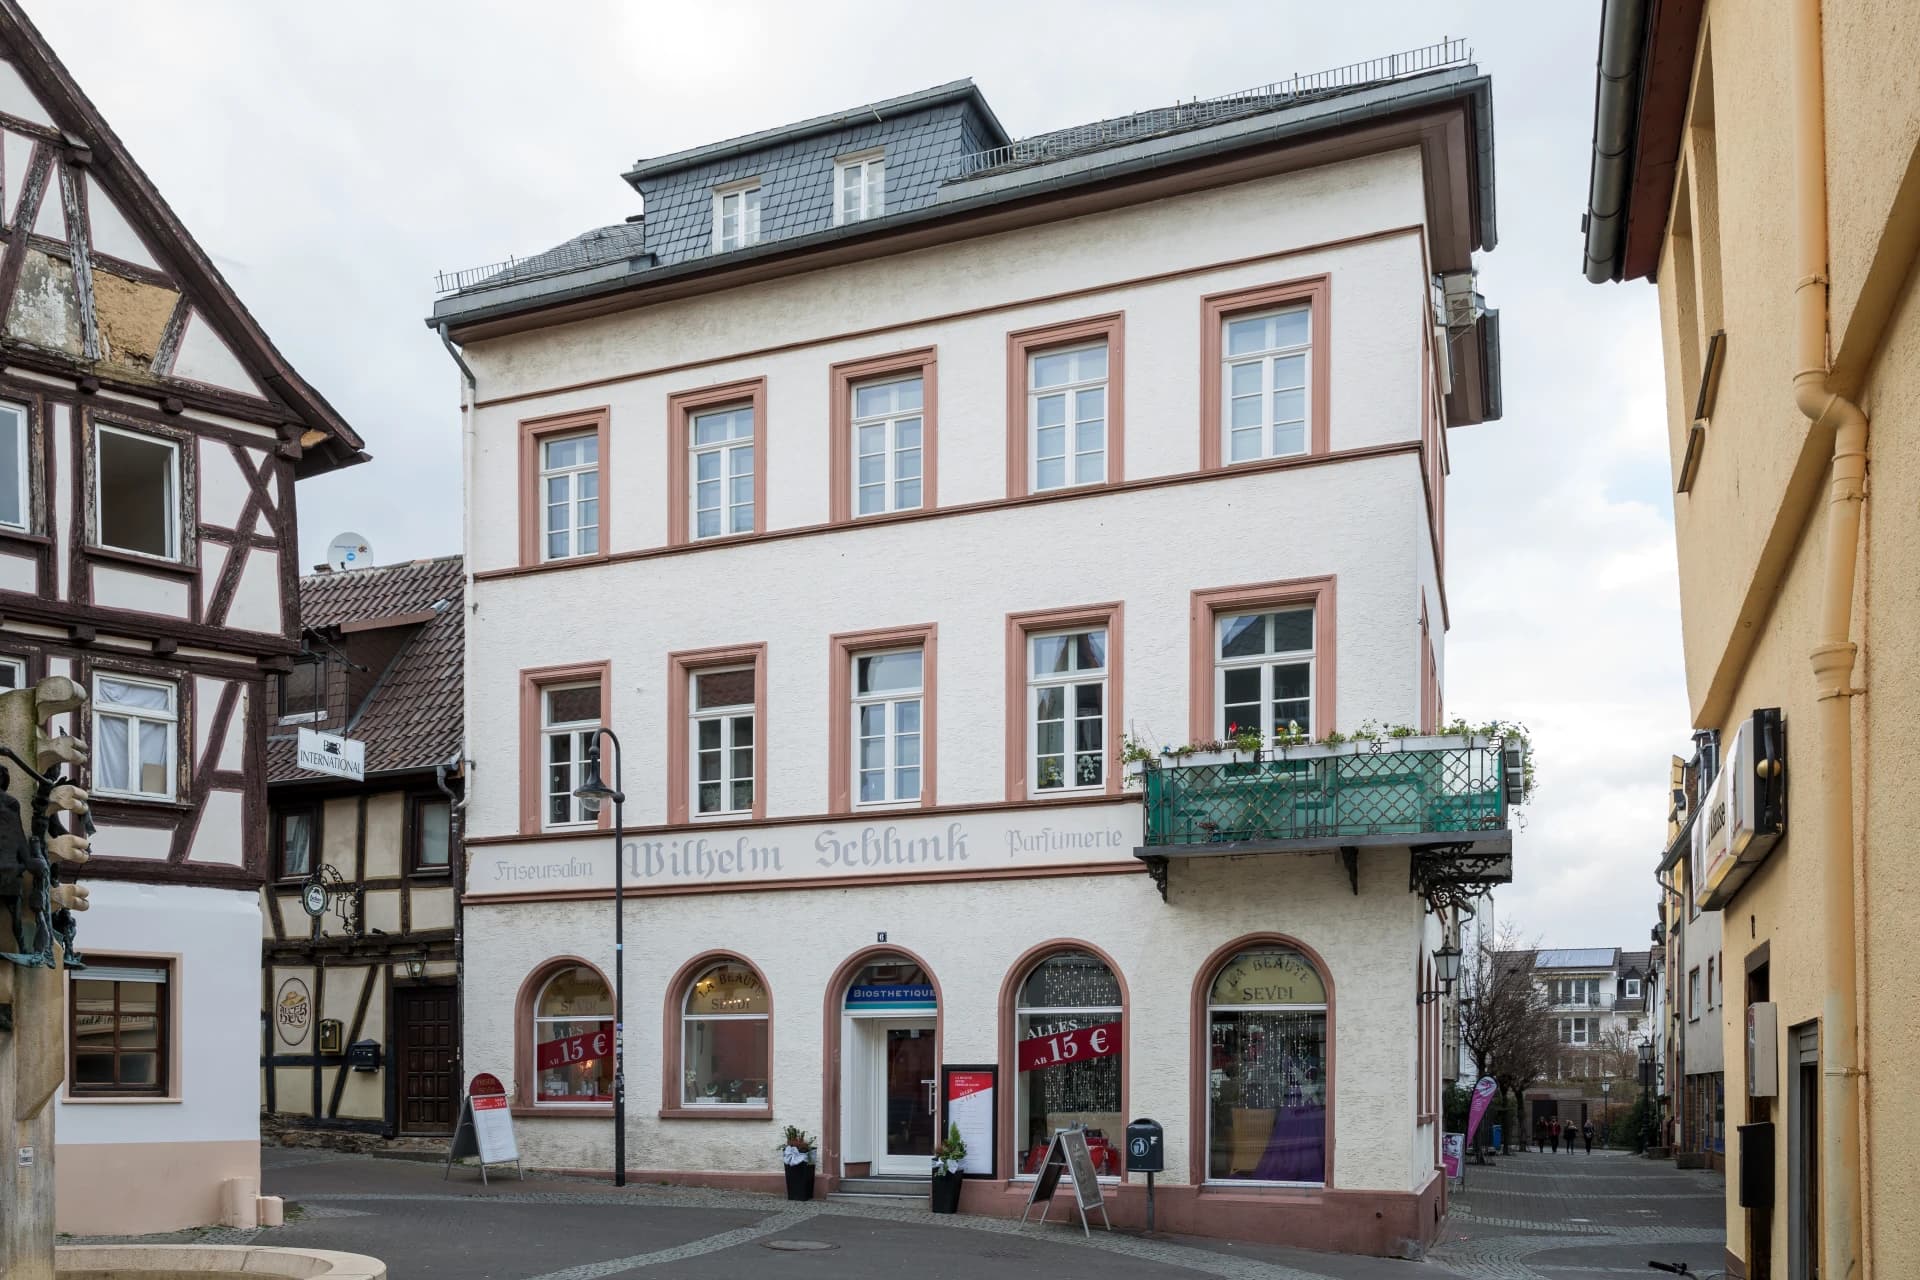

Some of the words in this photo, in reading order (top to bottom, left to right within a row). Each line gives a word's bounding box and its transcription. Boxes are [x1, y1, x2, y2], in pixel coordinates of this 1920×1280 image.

[301, 750, 363, 775] INTERNATIONAL
[494, 856, 593, 881] Friseursalon
[622, 836, 784, 879] Wilhelm
[814, 822, 970, 868] Schlunk
[1026, 1019, 1078, 1040] ALLES
[560, 1037, 584, 1063] 15
[592, 1033, 609, 1056] €
[1033, 1056, 1048, 1066] AB
[1048, 1032, 1078, 1063] 15
[1089, 1028, 1110, 1053] €
